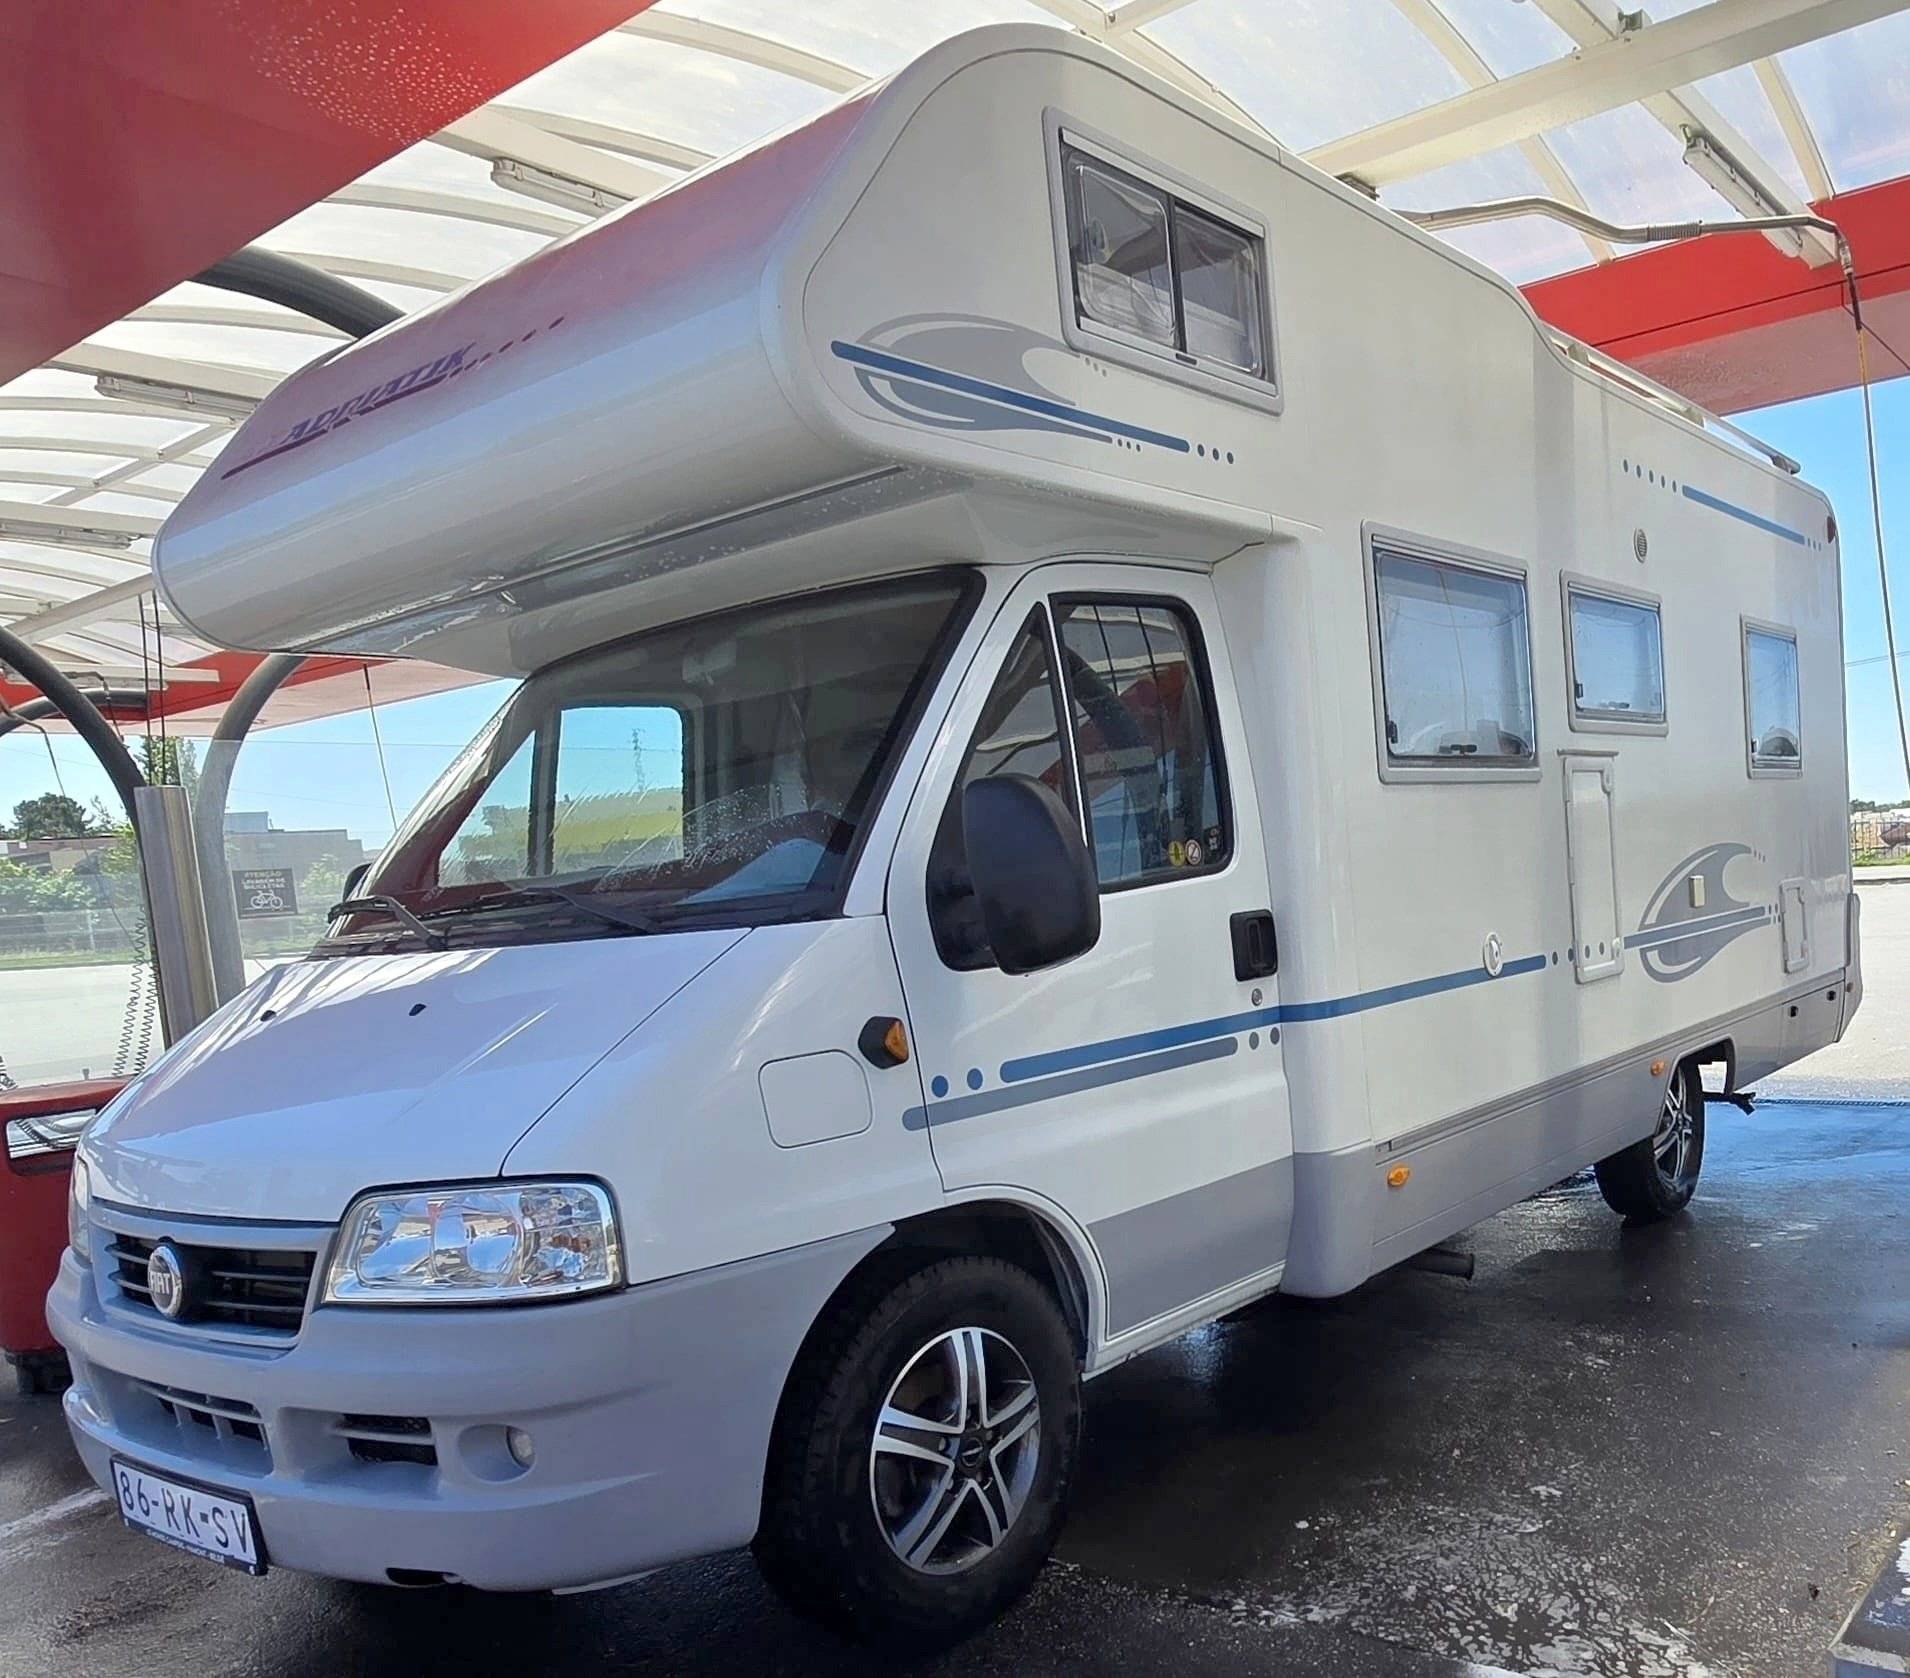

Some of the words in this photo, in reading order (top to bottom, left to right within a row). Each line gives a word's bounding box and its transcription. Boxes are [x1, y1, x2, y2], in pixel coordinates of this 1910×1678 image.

[281, 343, 475, 443] ADRIATIK
[150, 1271, 170, 1294] FIAT
[120, 1471, 248, 1553] 86-RK-SV
